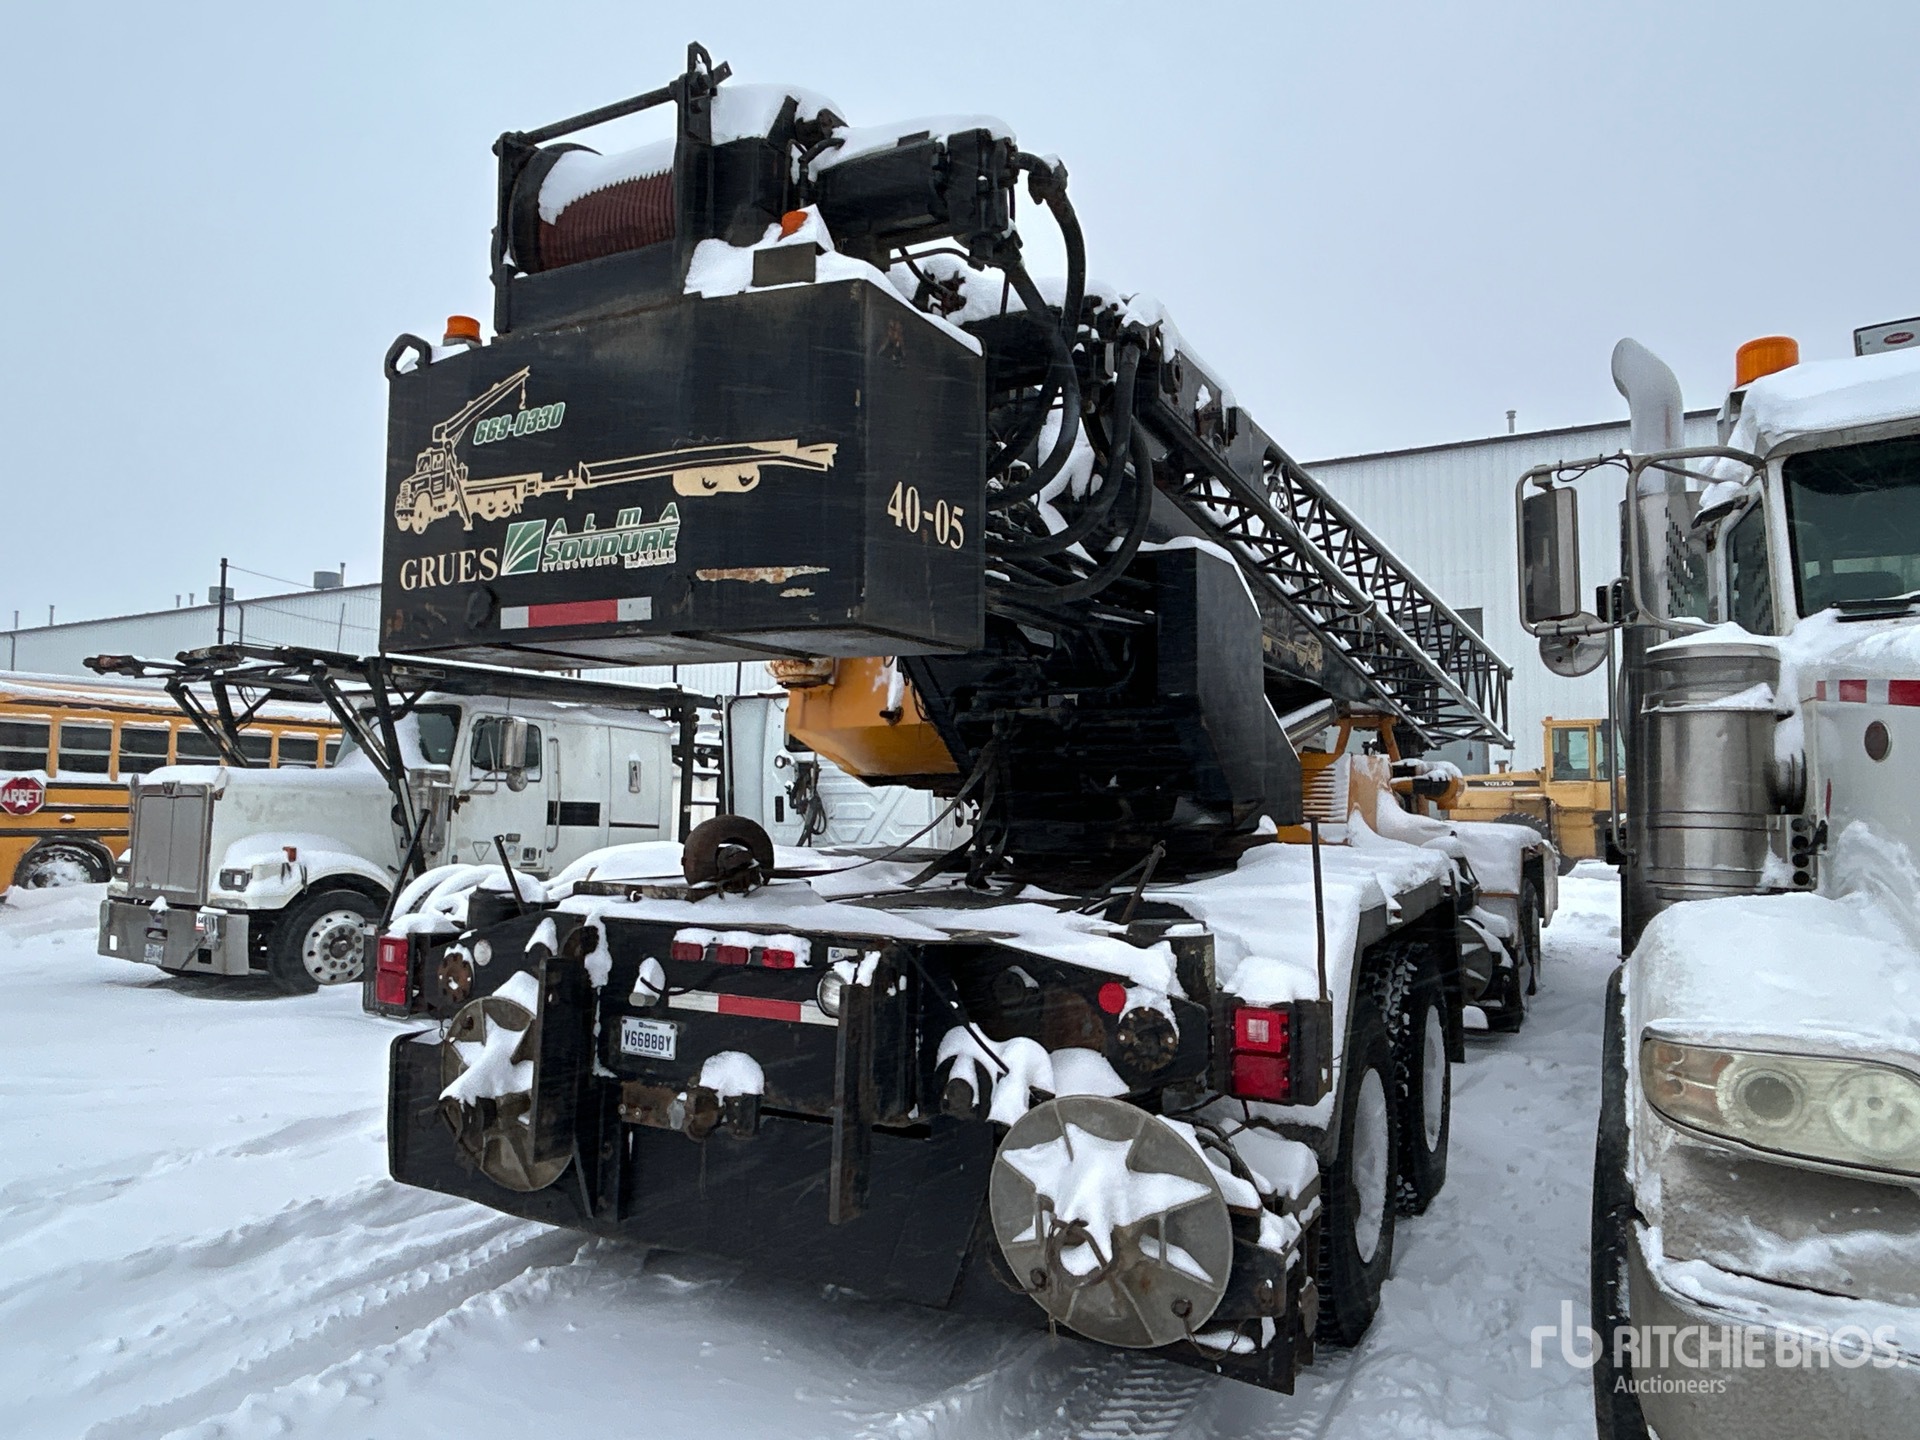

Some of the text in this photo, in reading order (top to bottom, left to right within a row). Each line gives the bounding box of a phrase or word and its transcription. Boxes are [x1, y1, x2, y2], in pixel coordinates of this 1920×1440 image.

[473, 402, 566, 445] 669-0330
[887, 481, 964, 549] 40-05
[543, 527, 679, 563] SOUDURE
[400, 548, 498, 591] GRUES
